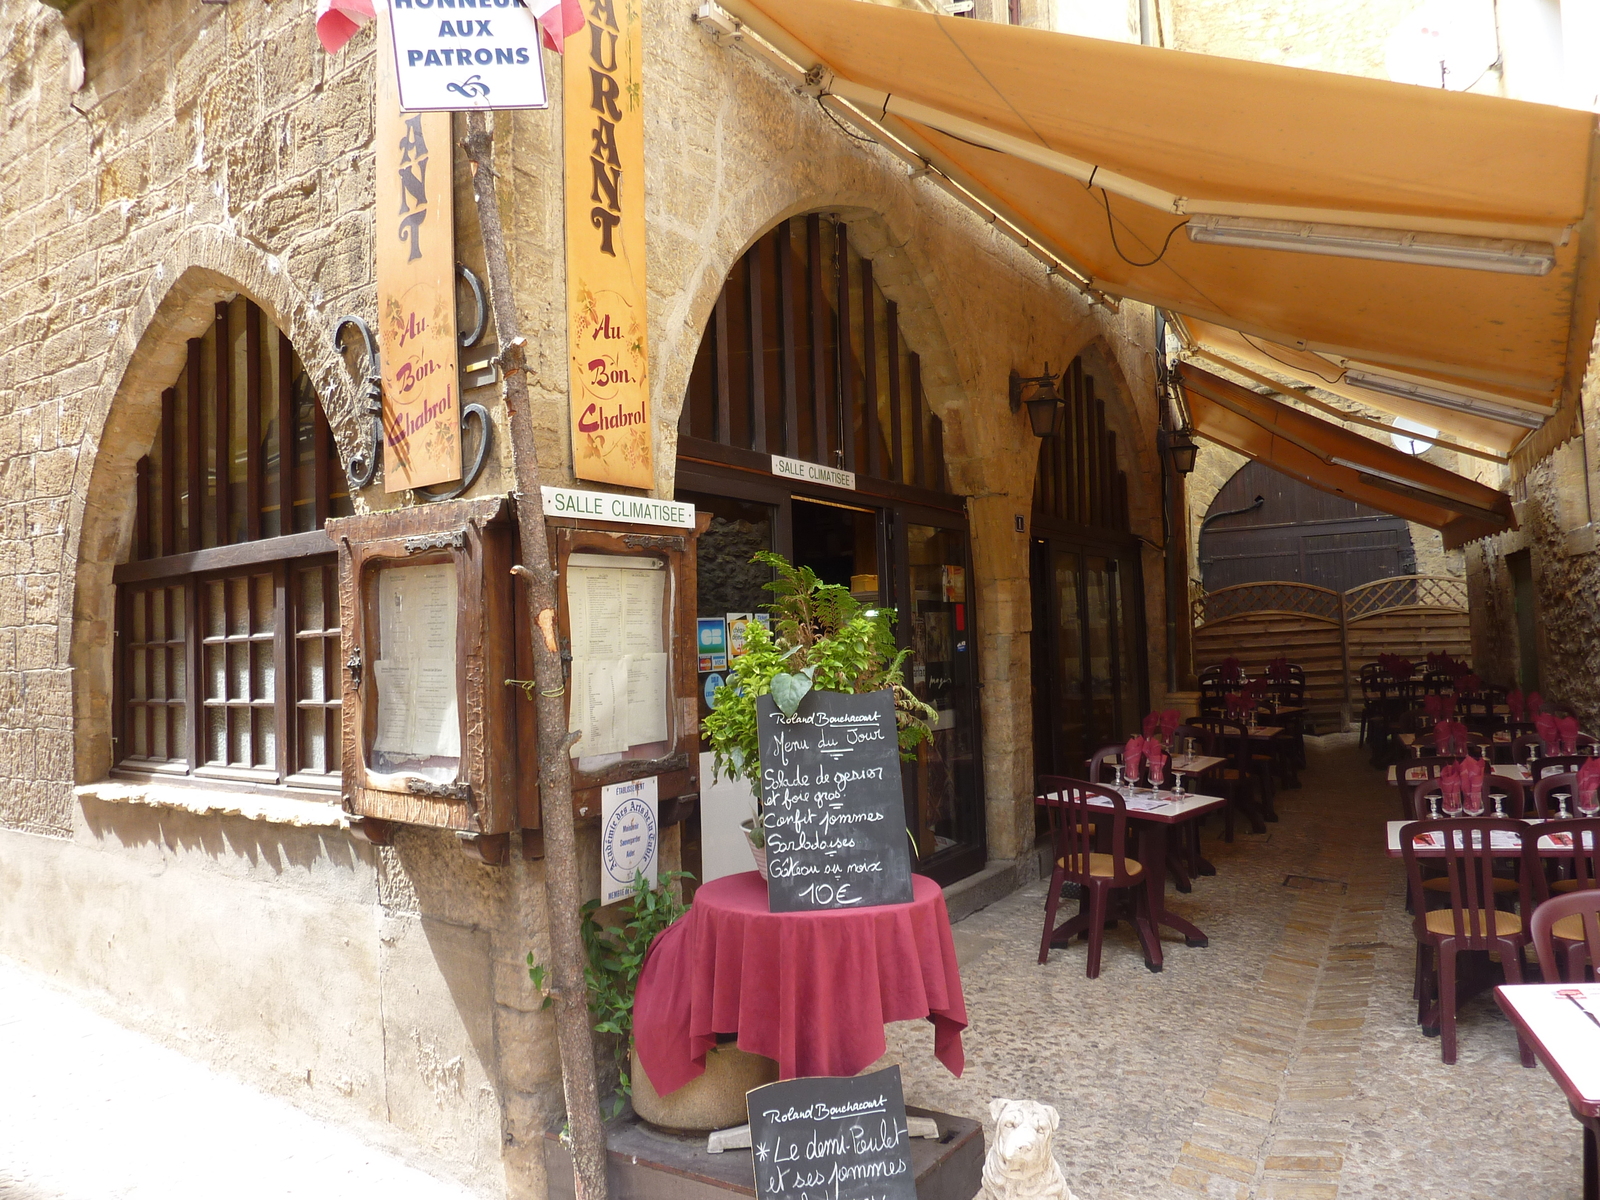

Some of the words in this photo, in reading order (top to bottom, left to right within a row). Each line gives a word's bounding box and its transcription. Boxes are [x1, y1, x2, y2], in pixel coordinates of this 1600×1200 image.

[438, 20, 494, 38] AUX
[407, 47, 530, 67] PATRONS
[387, 383, 452, 447] Chabrol
[578, 401, 646, 433] Chabrol
[779, 460, 805, 477] SALLE
[808, 466, 850, 486] CLIMATISEE
[555, 493, 603, 515] SALLE
[611, 499, 686, 523] CLIMATISEE
[769, 711, 814, 725] Roland
[773, 731, 809, 766] Menu
[817, 729, 838, 748] du
[846, 728, 885, 745] Jour
[764, 765, 810, 790] Salade
[816, 764, 830, 785] de
[764, 791, 780, 807] et
[782, 788, 810, 810] foie
[763, 809, 817, 834] Confit
[819, 811, 884, 836] pommes
[847, 858, 883, 874] noix
[799, 883, 863, 905] 10€
[762, 1104, 813, 1124] Roland
[774, 1136, 800, 1163] Le
[766, 1166, 791, 1194] et
[792, 1170, 825, 1188] ses
[828, 1158, 907, 1199] pommes
